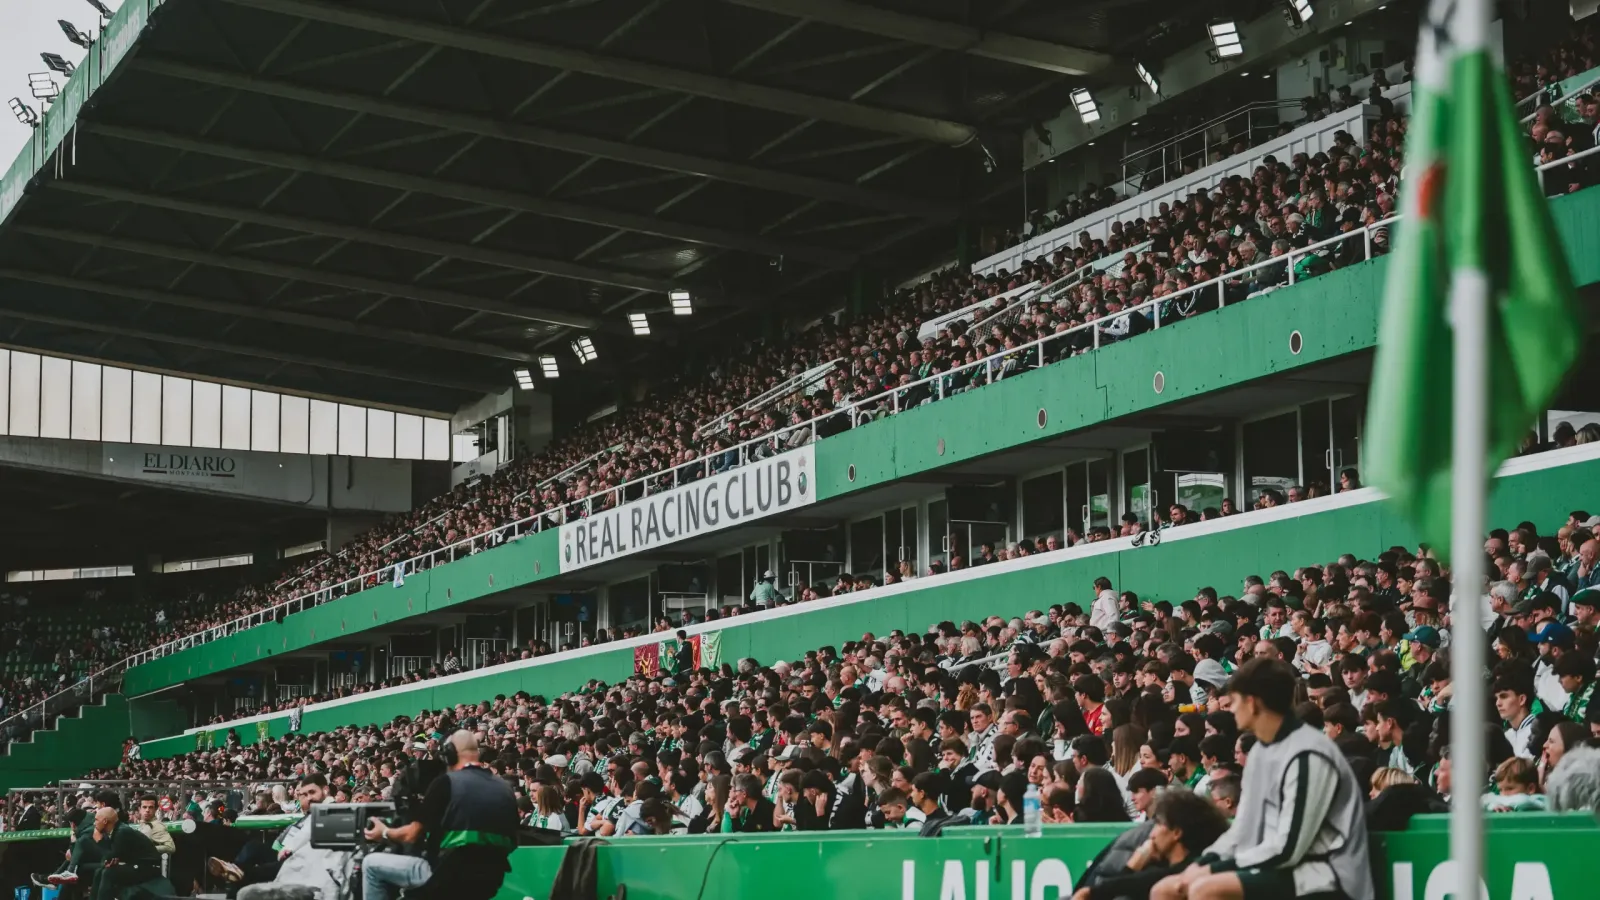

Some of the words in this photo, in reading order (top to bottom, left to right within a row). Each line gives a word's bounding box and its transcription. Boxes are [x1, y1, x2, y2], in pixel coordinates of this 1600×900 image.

[144, 453, 167, 468] EL
[170, 454, 235, 472] DIARIO
[576, 516, 627, 564] REAL
[631, 482, 719, 548] RACING
[725, 460, 792, 520] CLUB
